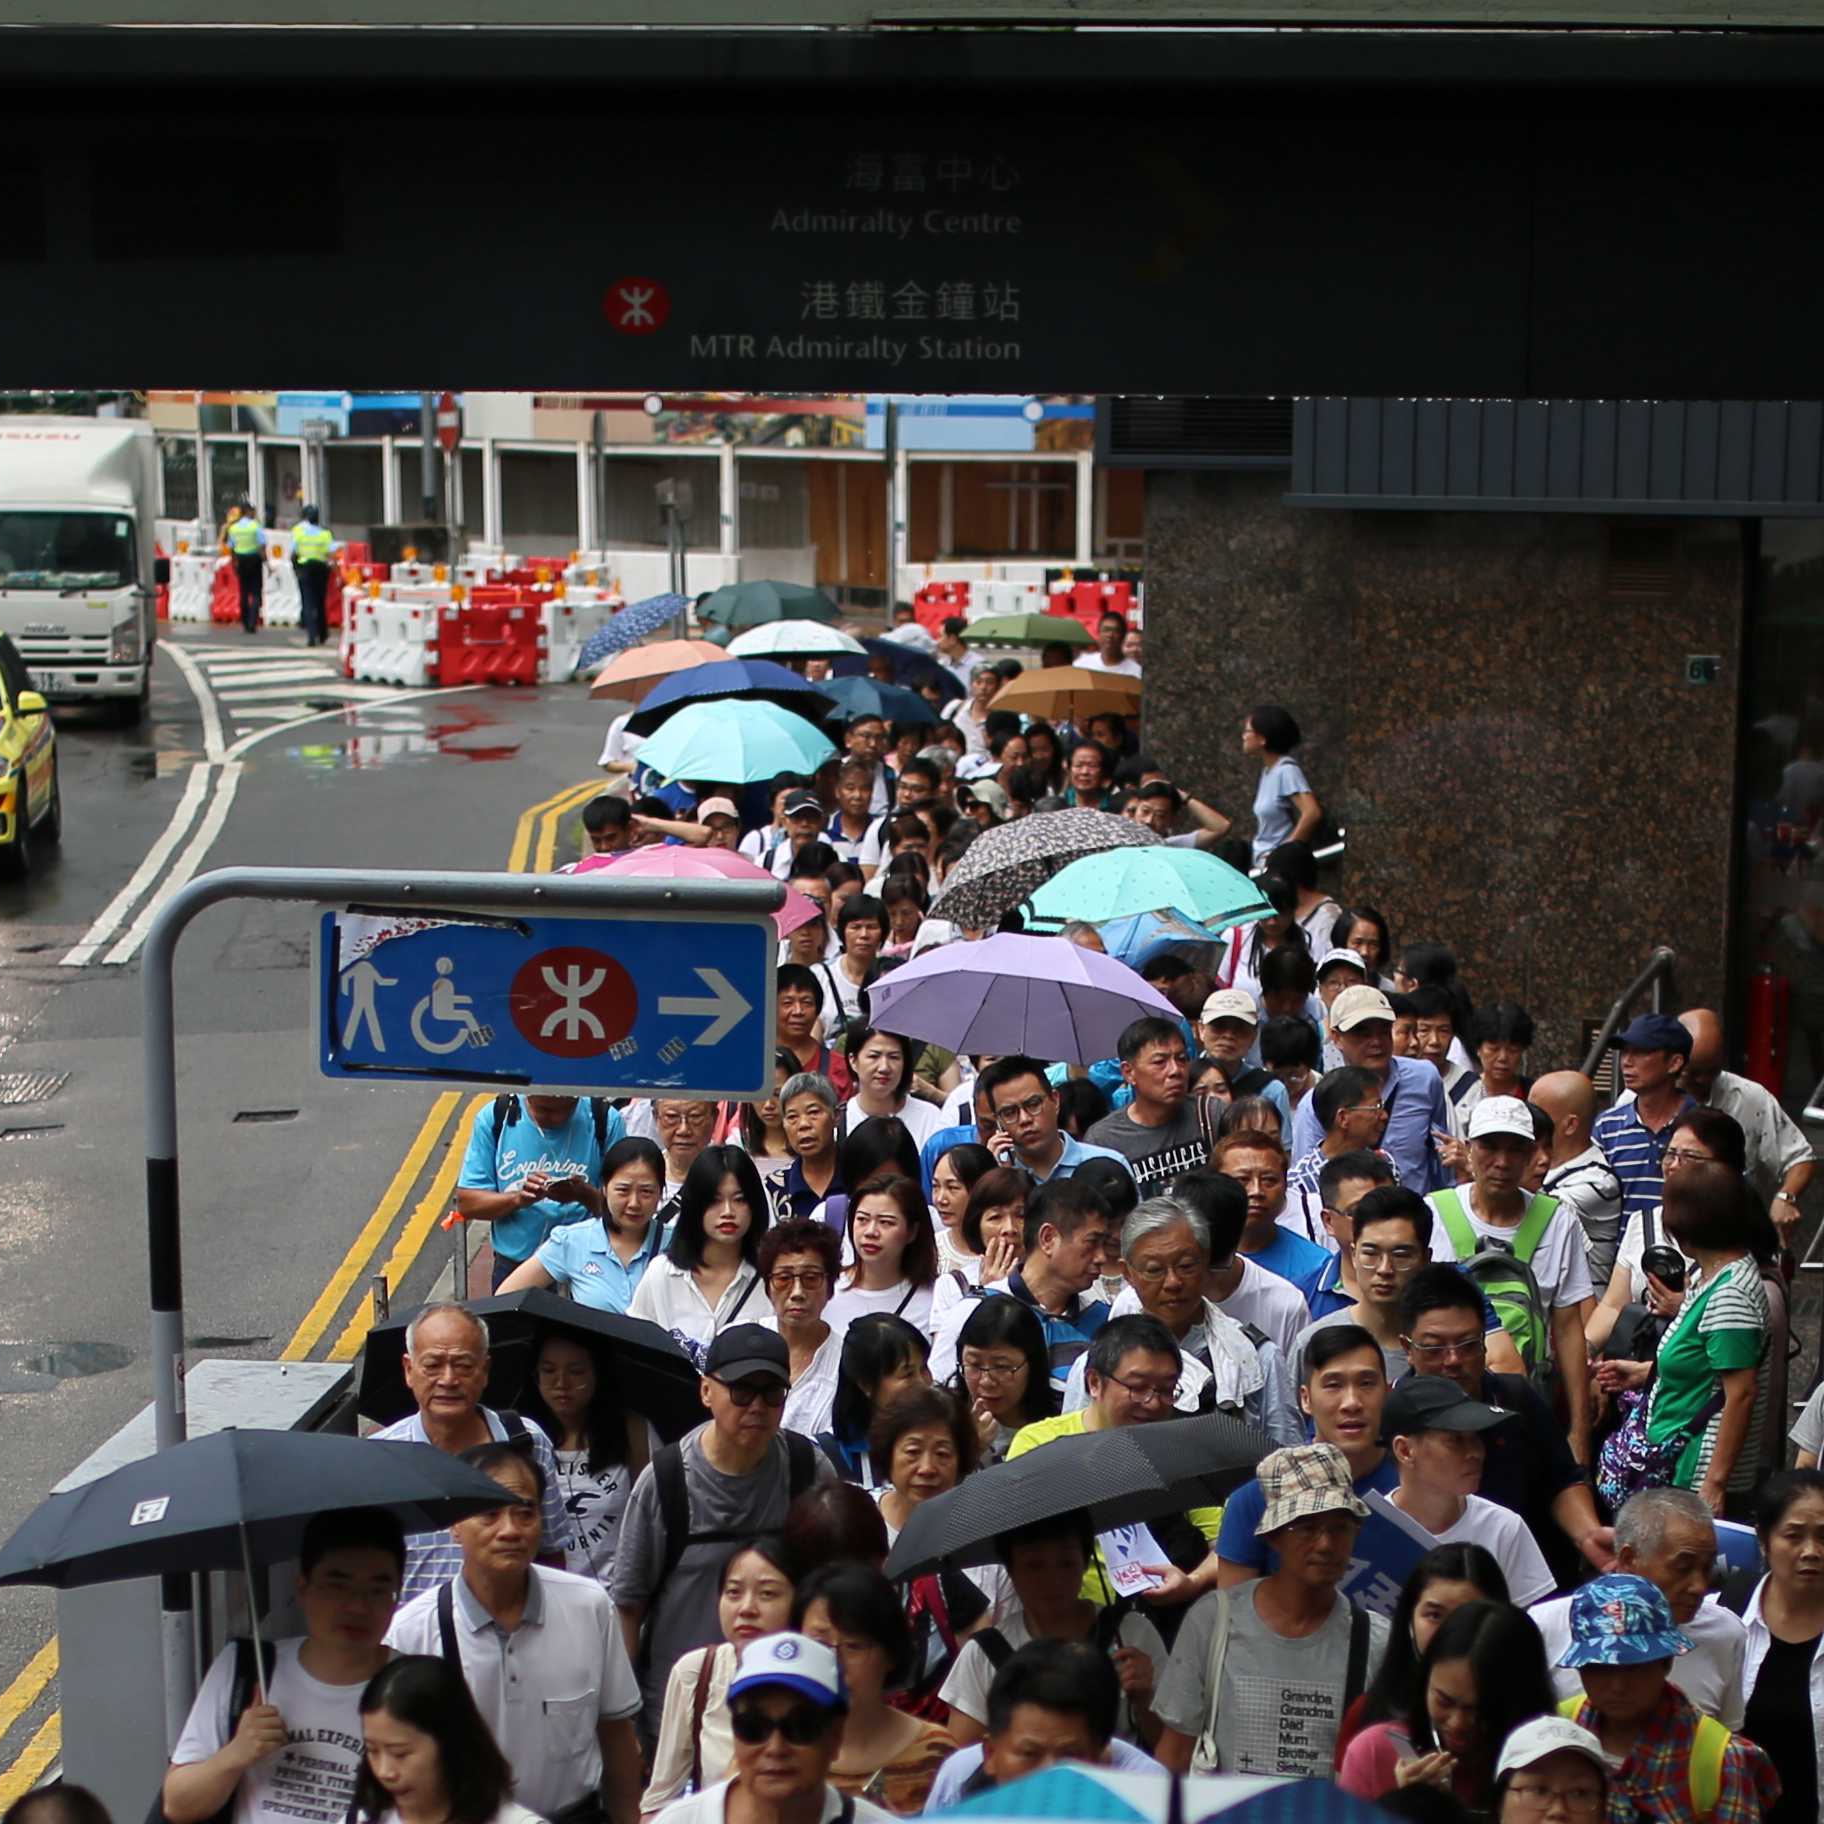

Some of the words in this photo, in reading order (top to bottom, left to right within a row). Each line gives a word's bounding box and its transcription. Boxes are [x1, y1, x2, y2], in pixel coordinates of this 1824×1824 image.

[844, 154, 1019, 192] 海富中心
[770, 208, 912, 239] Admiralty
[923, 210, 1021, 235] Centre
[801, 281, 1019, 320] 港鐵金鐘站
[691, 335, 756, 360] MTR
[766, 334, 907, 366] Admiralty
[918, 336, 1020, 361] Station
[1281, 1689, 1333, 1705] Grandpa
[1280, 1703, 1334, 1719] Grandma
[1279, 1717, 1304, 1731] Dad
[1279, 1732, 1308, 1746] Mum
[1277, 1746, 1319, 1761] Brother
